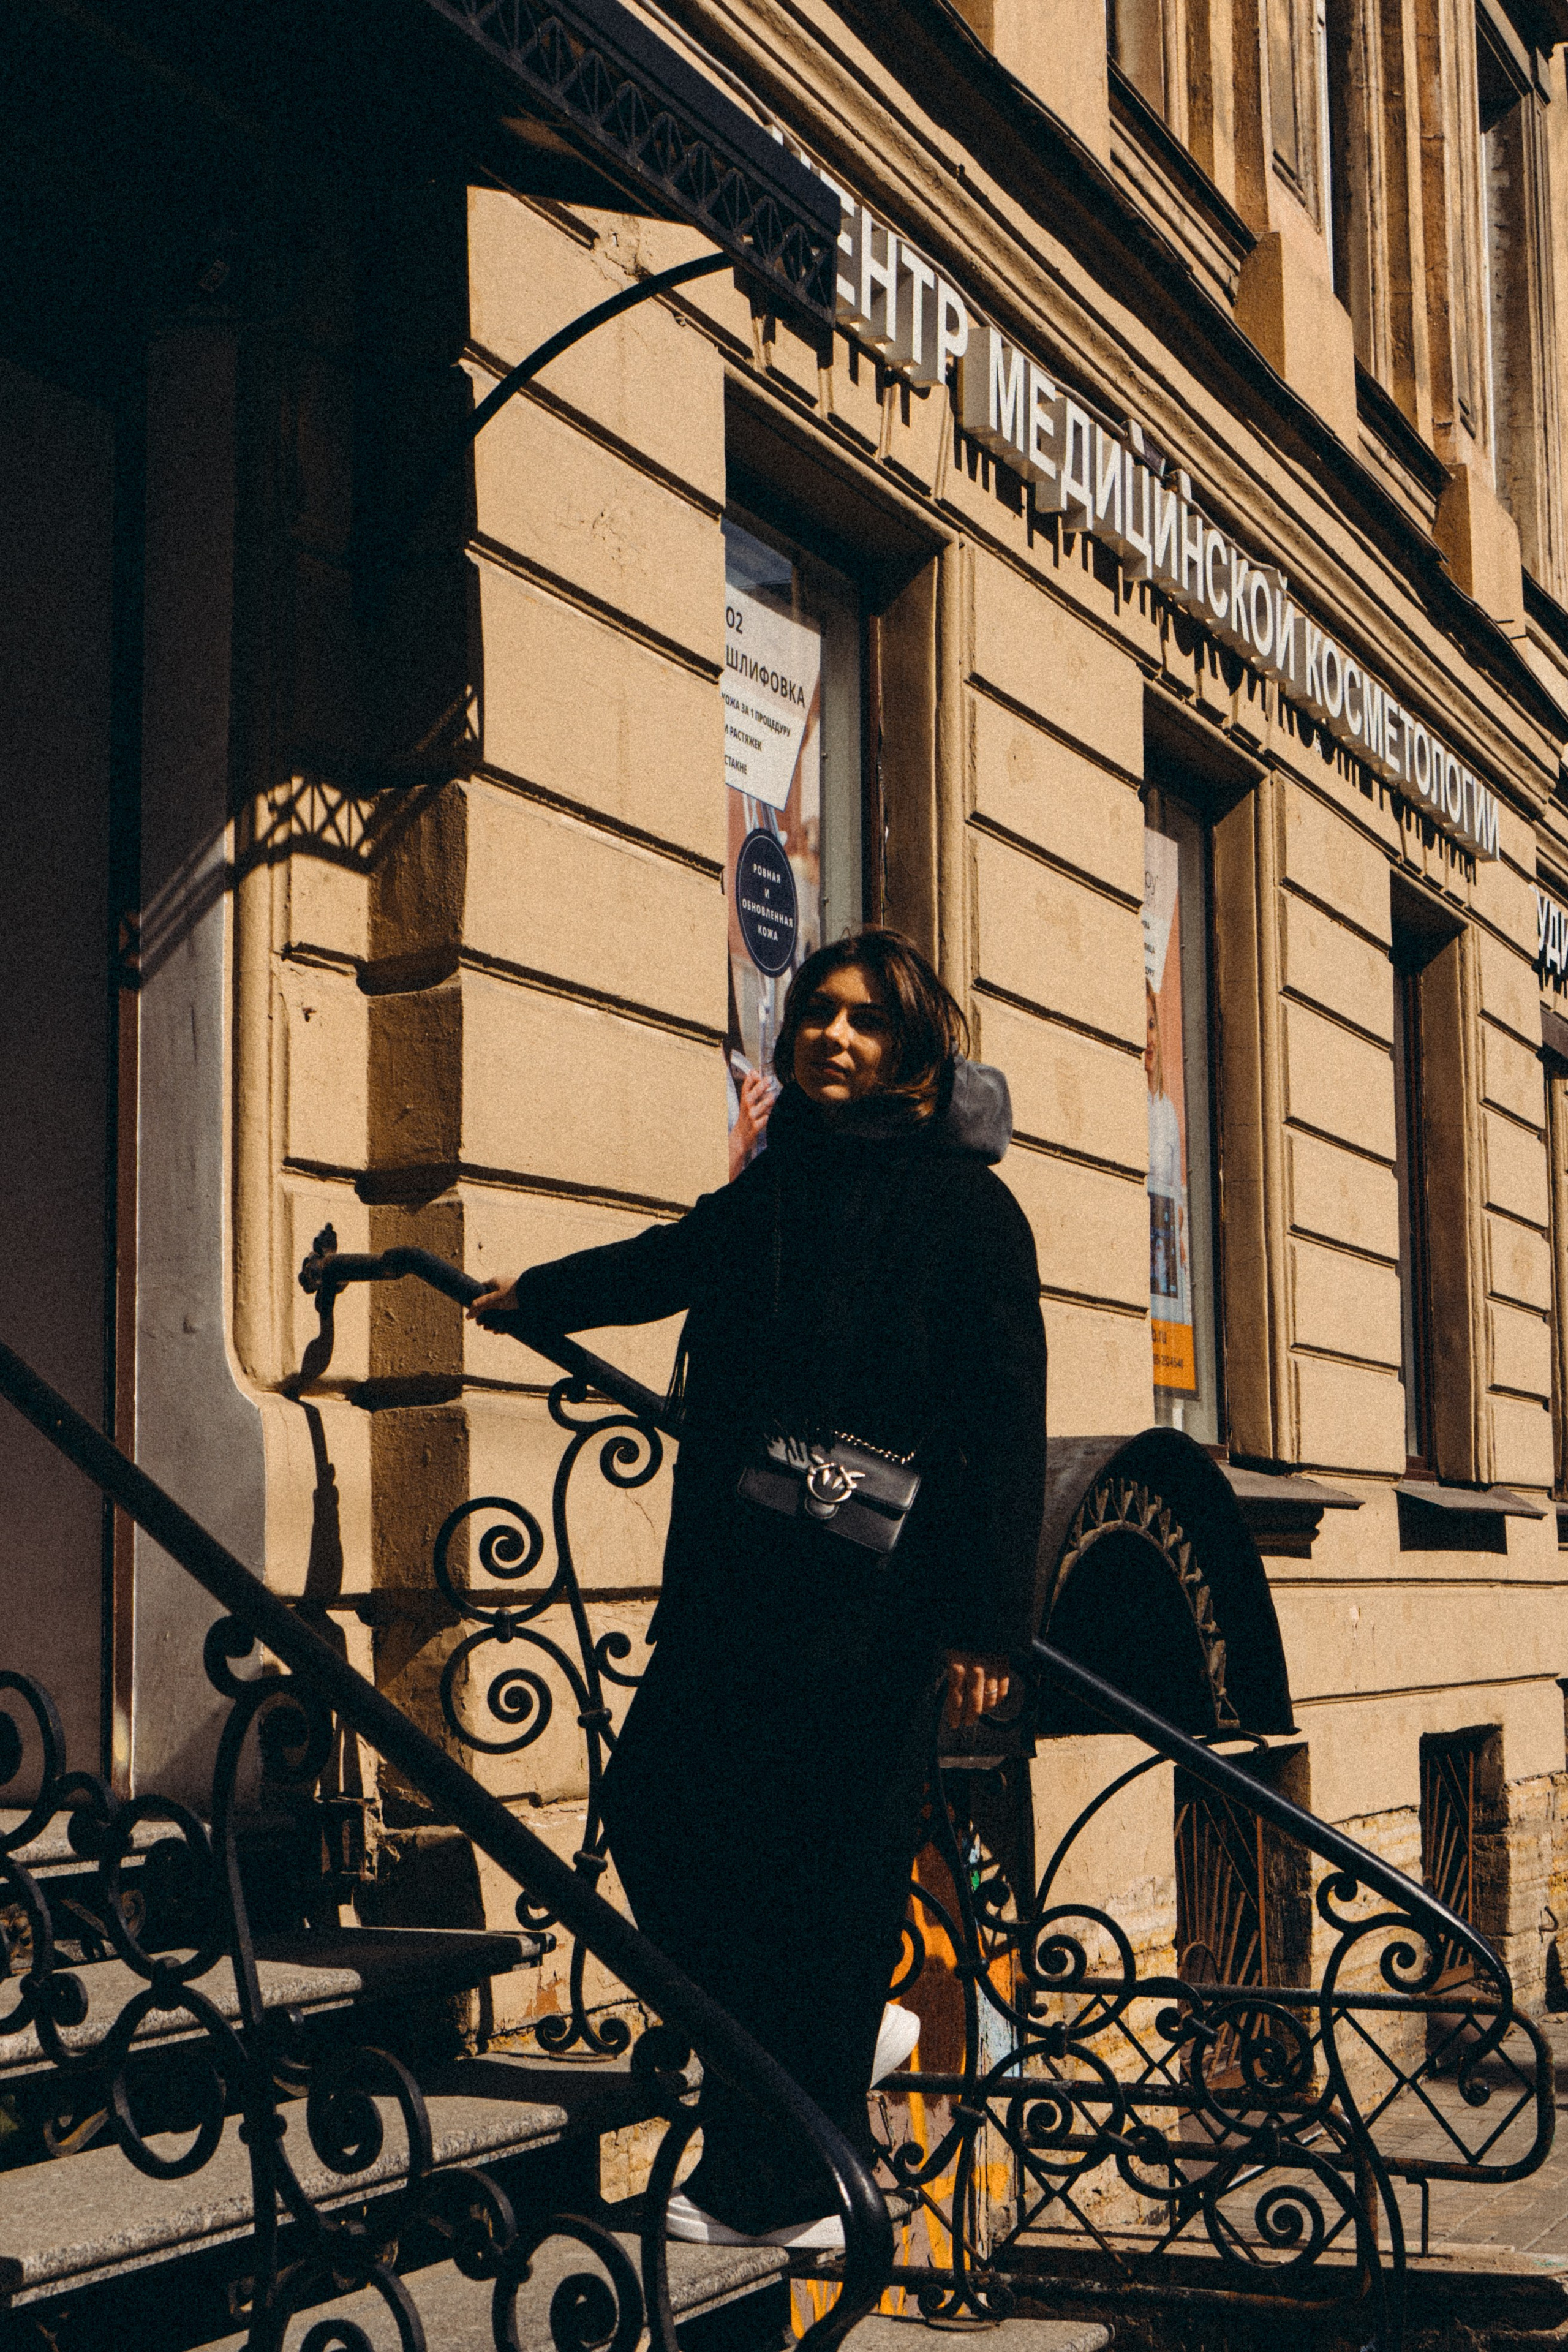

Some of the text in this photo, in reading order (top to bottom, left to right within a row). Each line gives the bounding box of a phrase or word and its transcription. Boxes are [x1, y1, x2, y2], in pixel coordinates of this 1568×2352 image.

[772, 124, 1500, 861] ЕНТР МЕДИЦИНСКОЙ КОСМЕТОЛОГИИ
[726, 644, 805, 709] ШЛИФОВКА
[741, 703, 749, 716] ЗА
[750, 708, 754, 718] 1
[755, 710, 791, 737] ПРОЦЕДУРУ
[729, 726, 762, 752] РАСТЯЖЕК
[753, 863, 781, 884] РОВНАЯ
[764, 888, 770, 899] И
[742, 898, 793, 928] ОБНОВЛЕННАЯ
[758, 924, 778, 941] КОЖА
